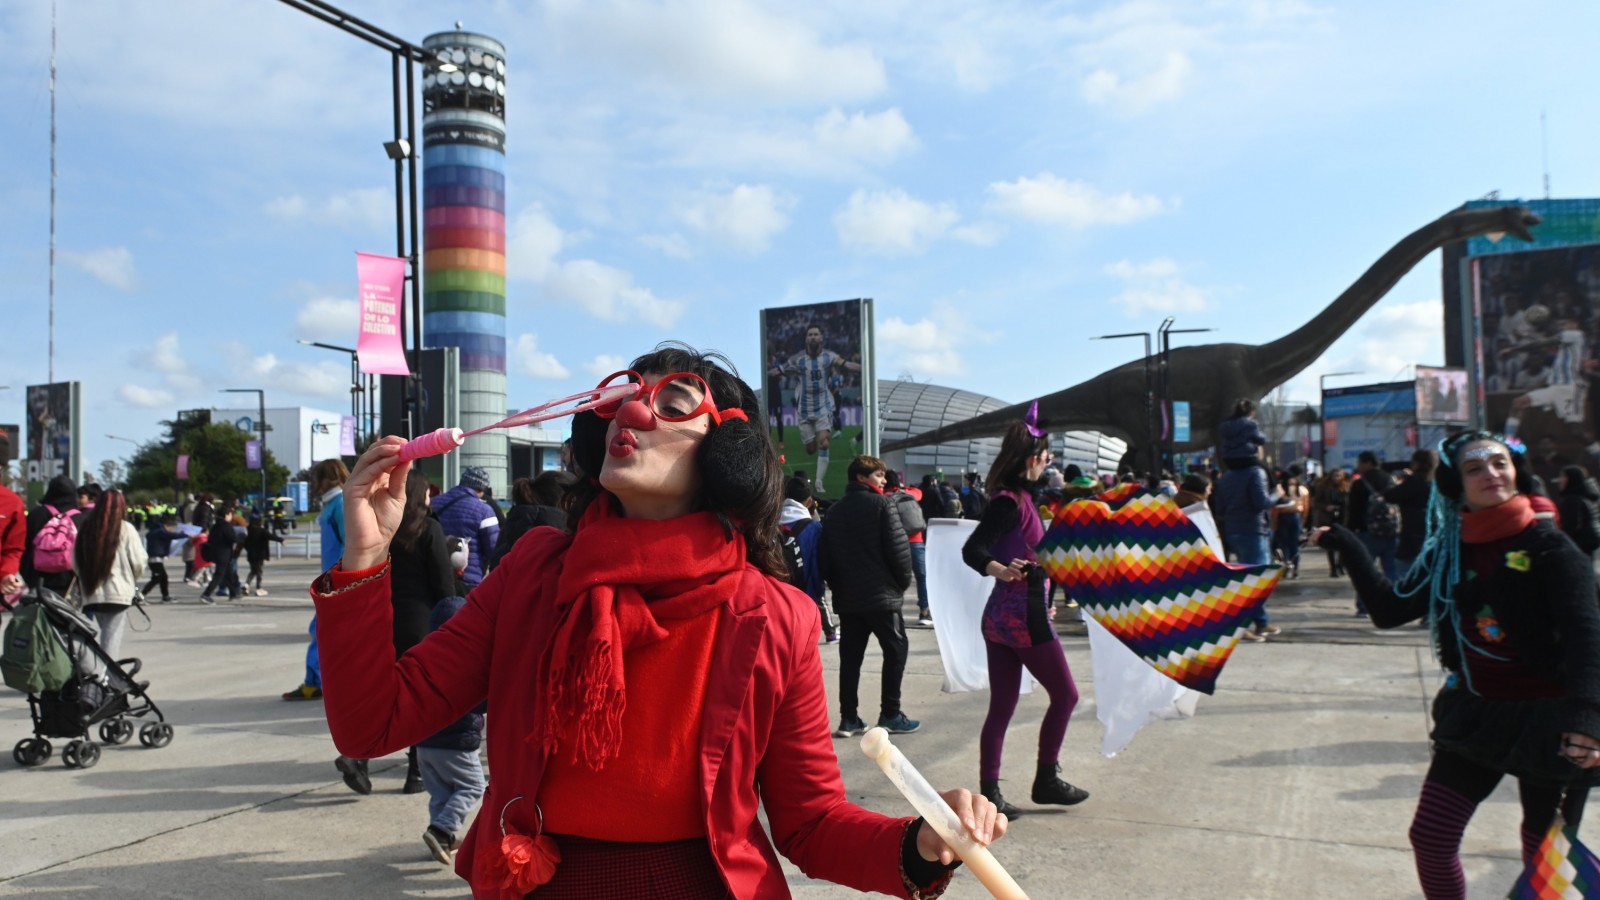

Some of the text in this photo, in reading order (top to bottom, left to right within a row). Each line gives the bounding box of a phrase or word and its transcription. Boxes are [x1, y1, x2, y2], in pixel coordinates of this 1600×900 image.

[363, 291, 376, 300] LA
[363, 300, 396, 316] POTENCIA
[363, 312, 390, 325] DE LO
